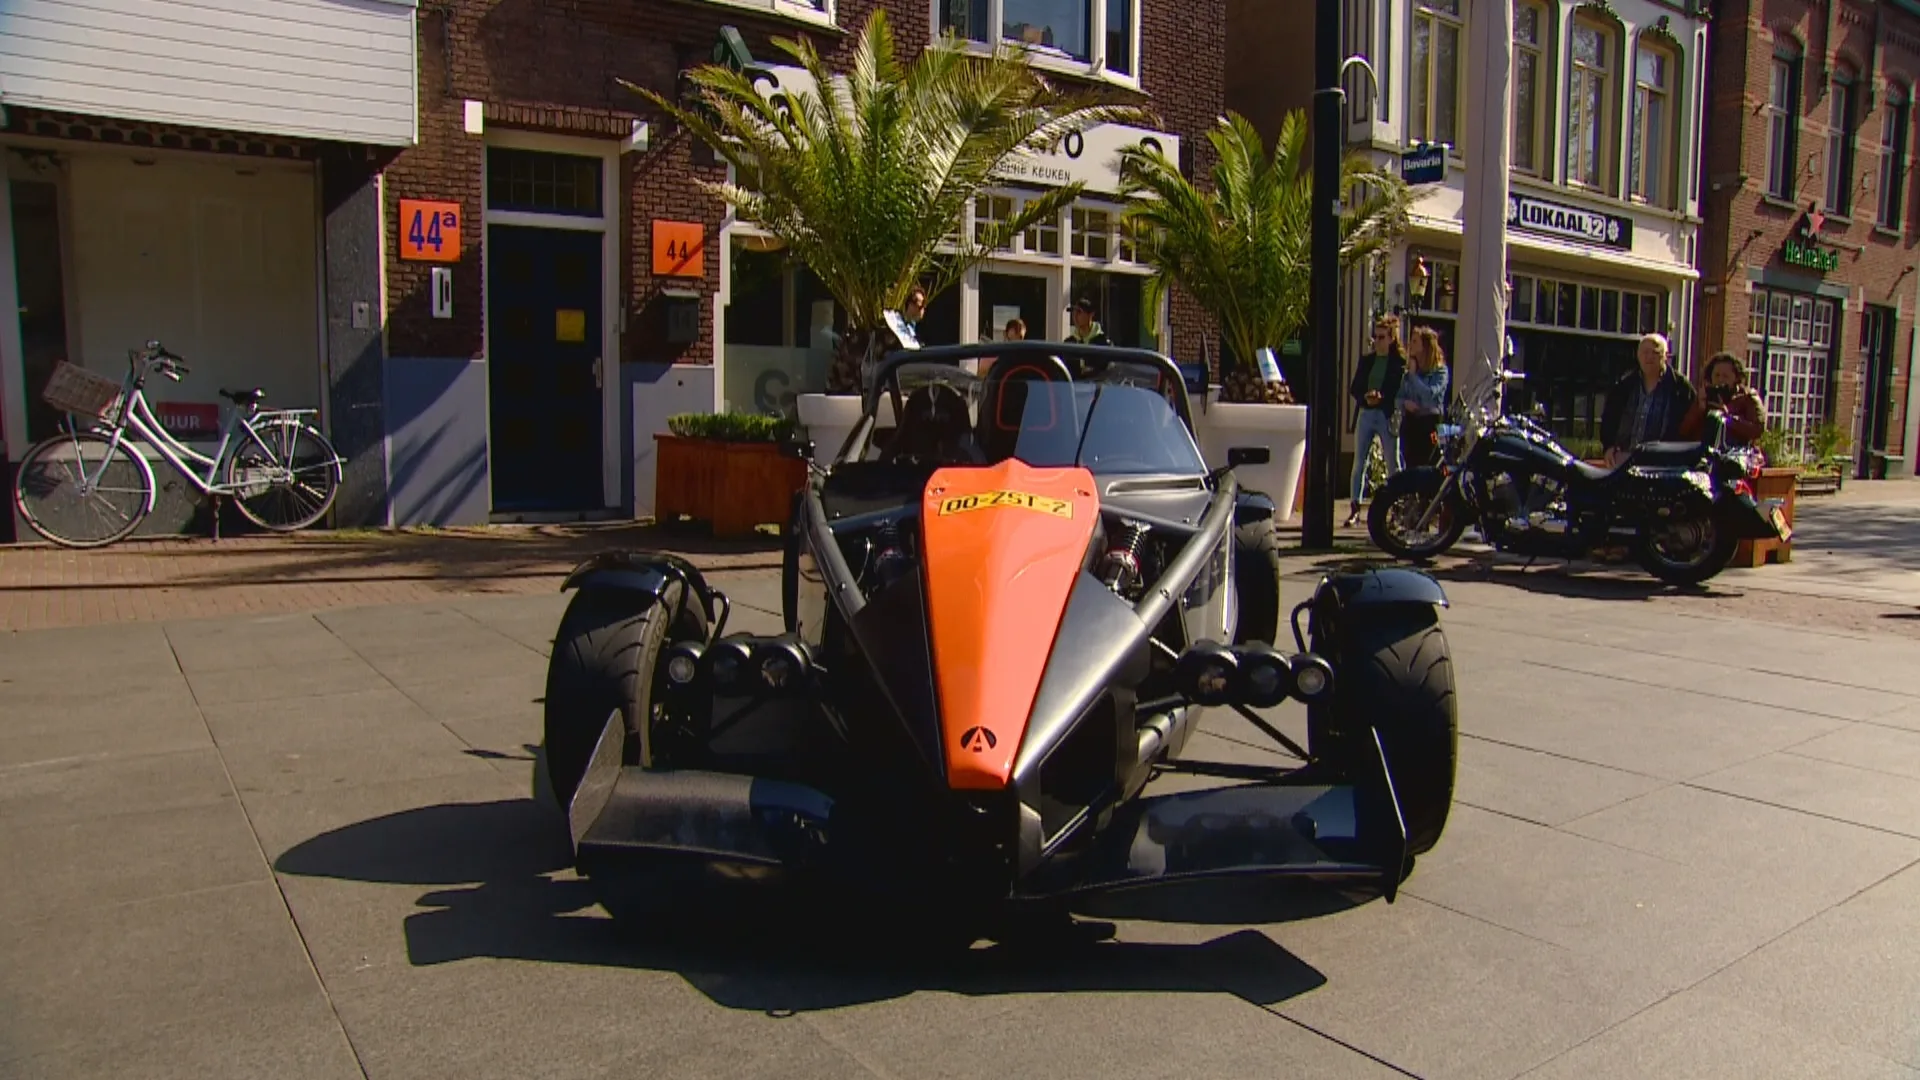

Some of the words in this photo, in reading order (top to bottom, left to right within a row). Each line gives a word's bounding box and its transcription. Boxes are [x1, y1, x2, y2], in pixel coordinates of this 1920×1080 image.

[1032, 162, 1071, 181] KEUKEN
[1403, 155, 1441, 170] Bavaria
[667, 240, 690, 261] 44
[1785, 240, 1838, 272] Heineken
